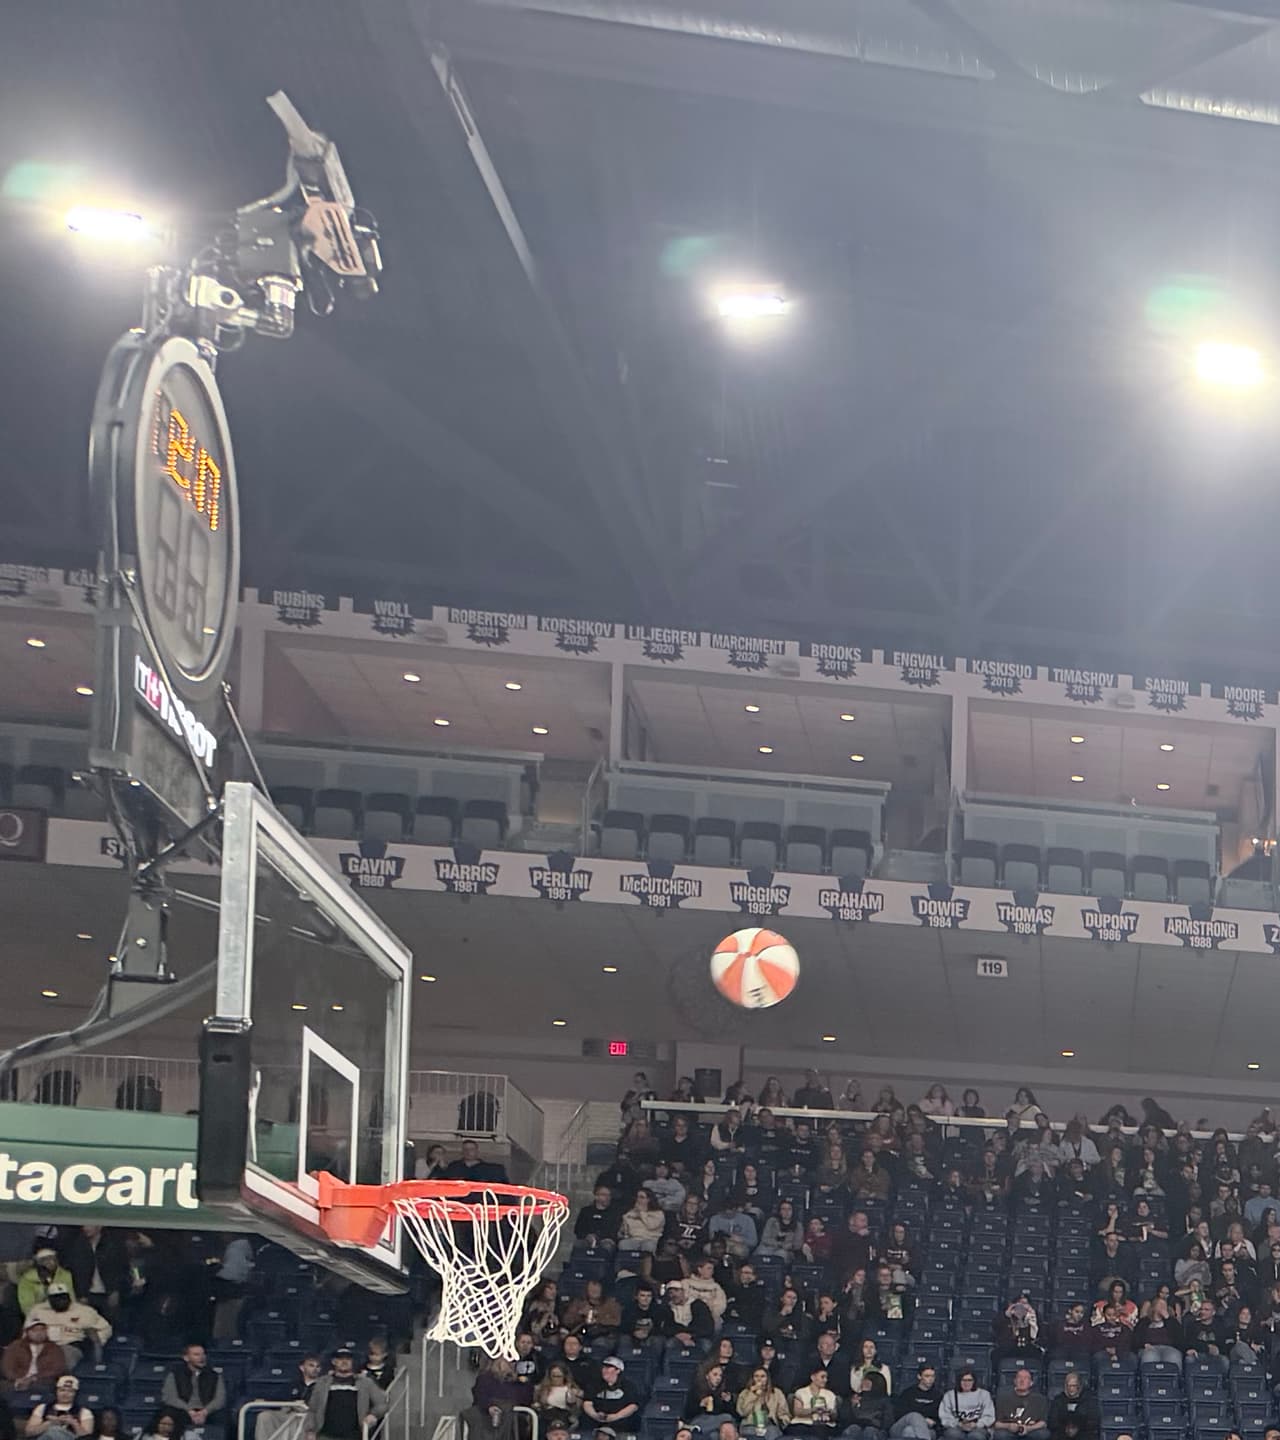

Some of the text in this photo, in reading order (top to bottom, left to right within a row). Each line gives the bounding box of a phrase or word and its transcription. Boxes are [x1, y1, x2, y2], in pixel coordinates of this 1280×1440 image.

[374, 601, 411, 618] WOLL
[381, 615, 405, 629] 2021
[451, 608, 525, 628] ROBERTSON
[475, 625, 499, 638] 2021
[542, 617, 612, 637] KORSHKOV
[629, 625, 697, 645] LILJEGREN
[563, 635, 588, 648] 2020
[650, 643, 675, 655] 2020
[712, 634, 784, 654] MARCHMENT
[735, 651, 760, 663] 2020
[811, 644, 861, 661] BROOKS
[824, 660, 847, 671] 2019
[894, 653, 946, 670] ENGVALL
[972, 660, 1033, 679] KASKISUO
[908, 668, 932, 680] 2019
[990, 675, 1014, 688] 2019
[1053, 668, 1114, 687] TIMASHOV
[1145, 678, 1189, 694] SANDIN
[1224, 686, 1265, 703] MOORE
[1234, 701, 1255, 713] 2018
[348, 857, 396, 876] GAVIN
[439, 862, 495, 883] HARRIS
[358, 873, 385, 887] 1980
[453, 880, 478, 892] 1981
[533, 870, 589, 890] PERLINI
[623, 876, 699, 898] McCUTCHEON
[548, 887, 572, 900] 1981
[647, 894, 671, 907] 1981
[734, 885, 788, 905] HIGGINS
[821, 891, 883, 911] GRAHAM
[748, 903, 772, 915] 1982
[838, 908, 863, 921] 1983
[918, 900, 964, 919] DOWIE
[998, 905, 1053, 924] THOMAS
[928, 915, 952, 928] 1984
[1014, 921, 1037, 934] 1984
[1085, 913, 1136, 931] DUPONT
[1167, 918, 1236, 938] ARMSTRONG
[1098, 928, 1121, 940] 1986
[1190, 935, 1212, 948] 1988
[981, 961, 1002, 975] 119
